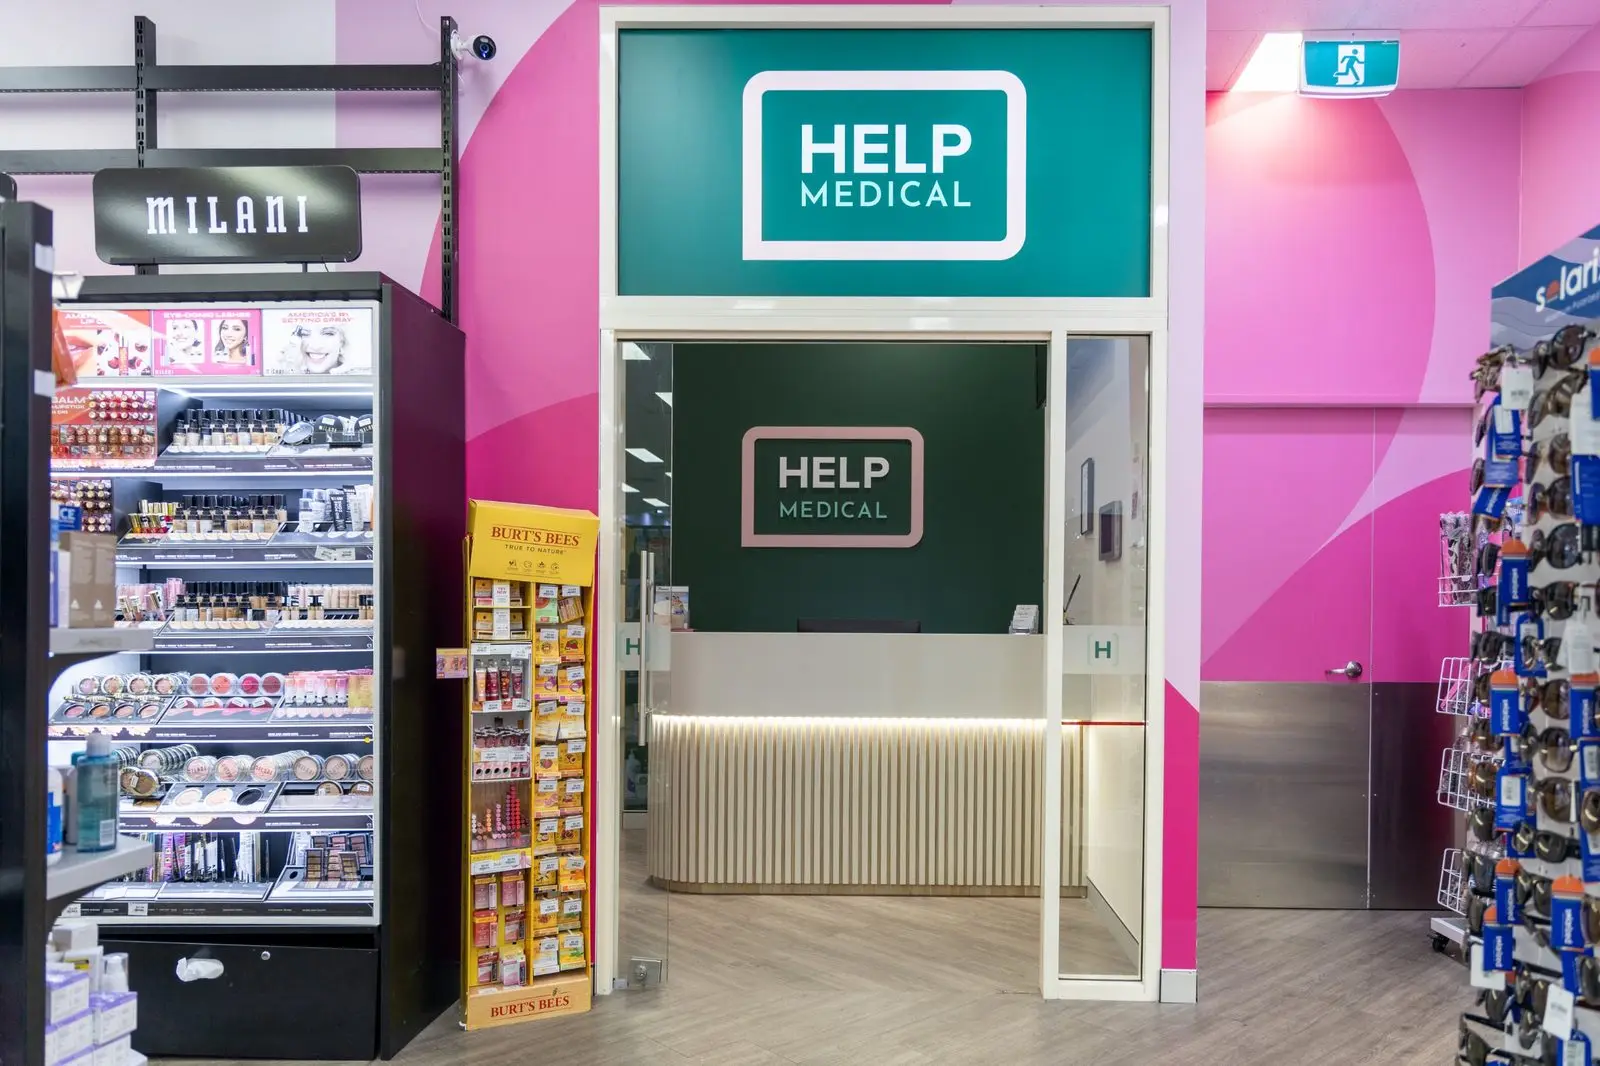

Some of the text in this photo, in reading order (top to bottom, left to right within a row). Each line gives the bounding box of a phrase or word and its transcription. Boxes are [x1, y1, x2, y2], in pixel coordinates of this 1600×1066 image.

[801, 123, 972, 174] HELP
[801, 180, 972, 207] MEDICAL
[146, 195, 309, 235] MILANI
[779, 456, 890, 489] HELP
[779, 501, 888, 519] MEDICAL
[491, 526, 580, 547] BURT'S BEES
[505, 543, 524, 551] TRUE
[625, 637, 641, 656] H
[1094, 640, 1112, 659] H
[491, 995, 571, 1018] BURT'S BEES
